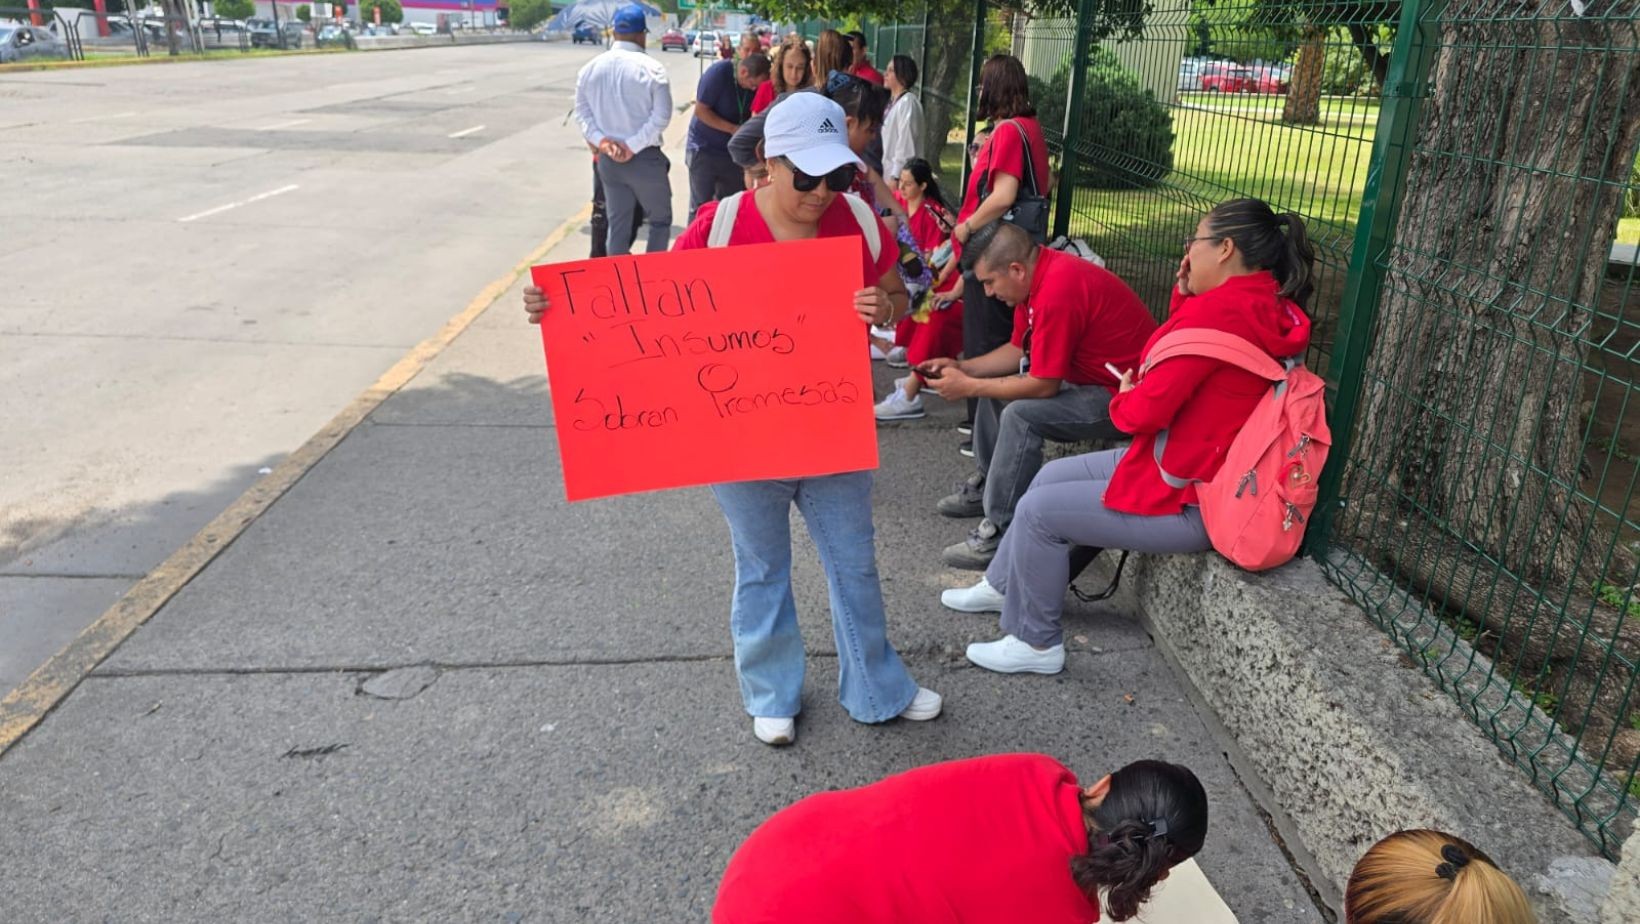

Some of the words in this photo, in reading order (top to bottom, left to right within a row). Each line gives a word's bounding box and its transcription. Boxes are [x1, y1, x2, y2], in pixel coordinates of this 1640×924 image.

[556, 261, 717, 319] Faltan
[573, 388, 678, 431] Sobran
[698, 364, 858, 418] Promesas
